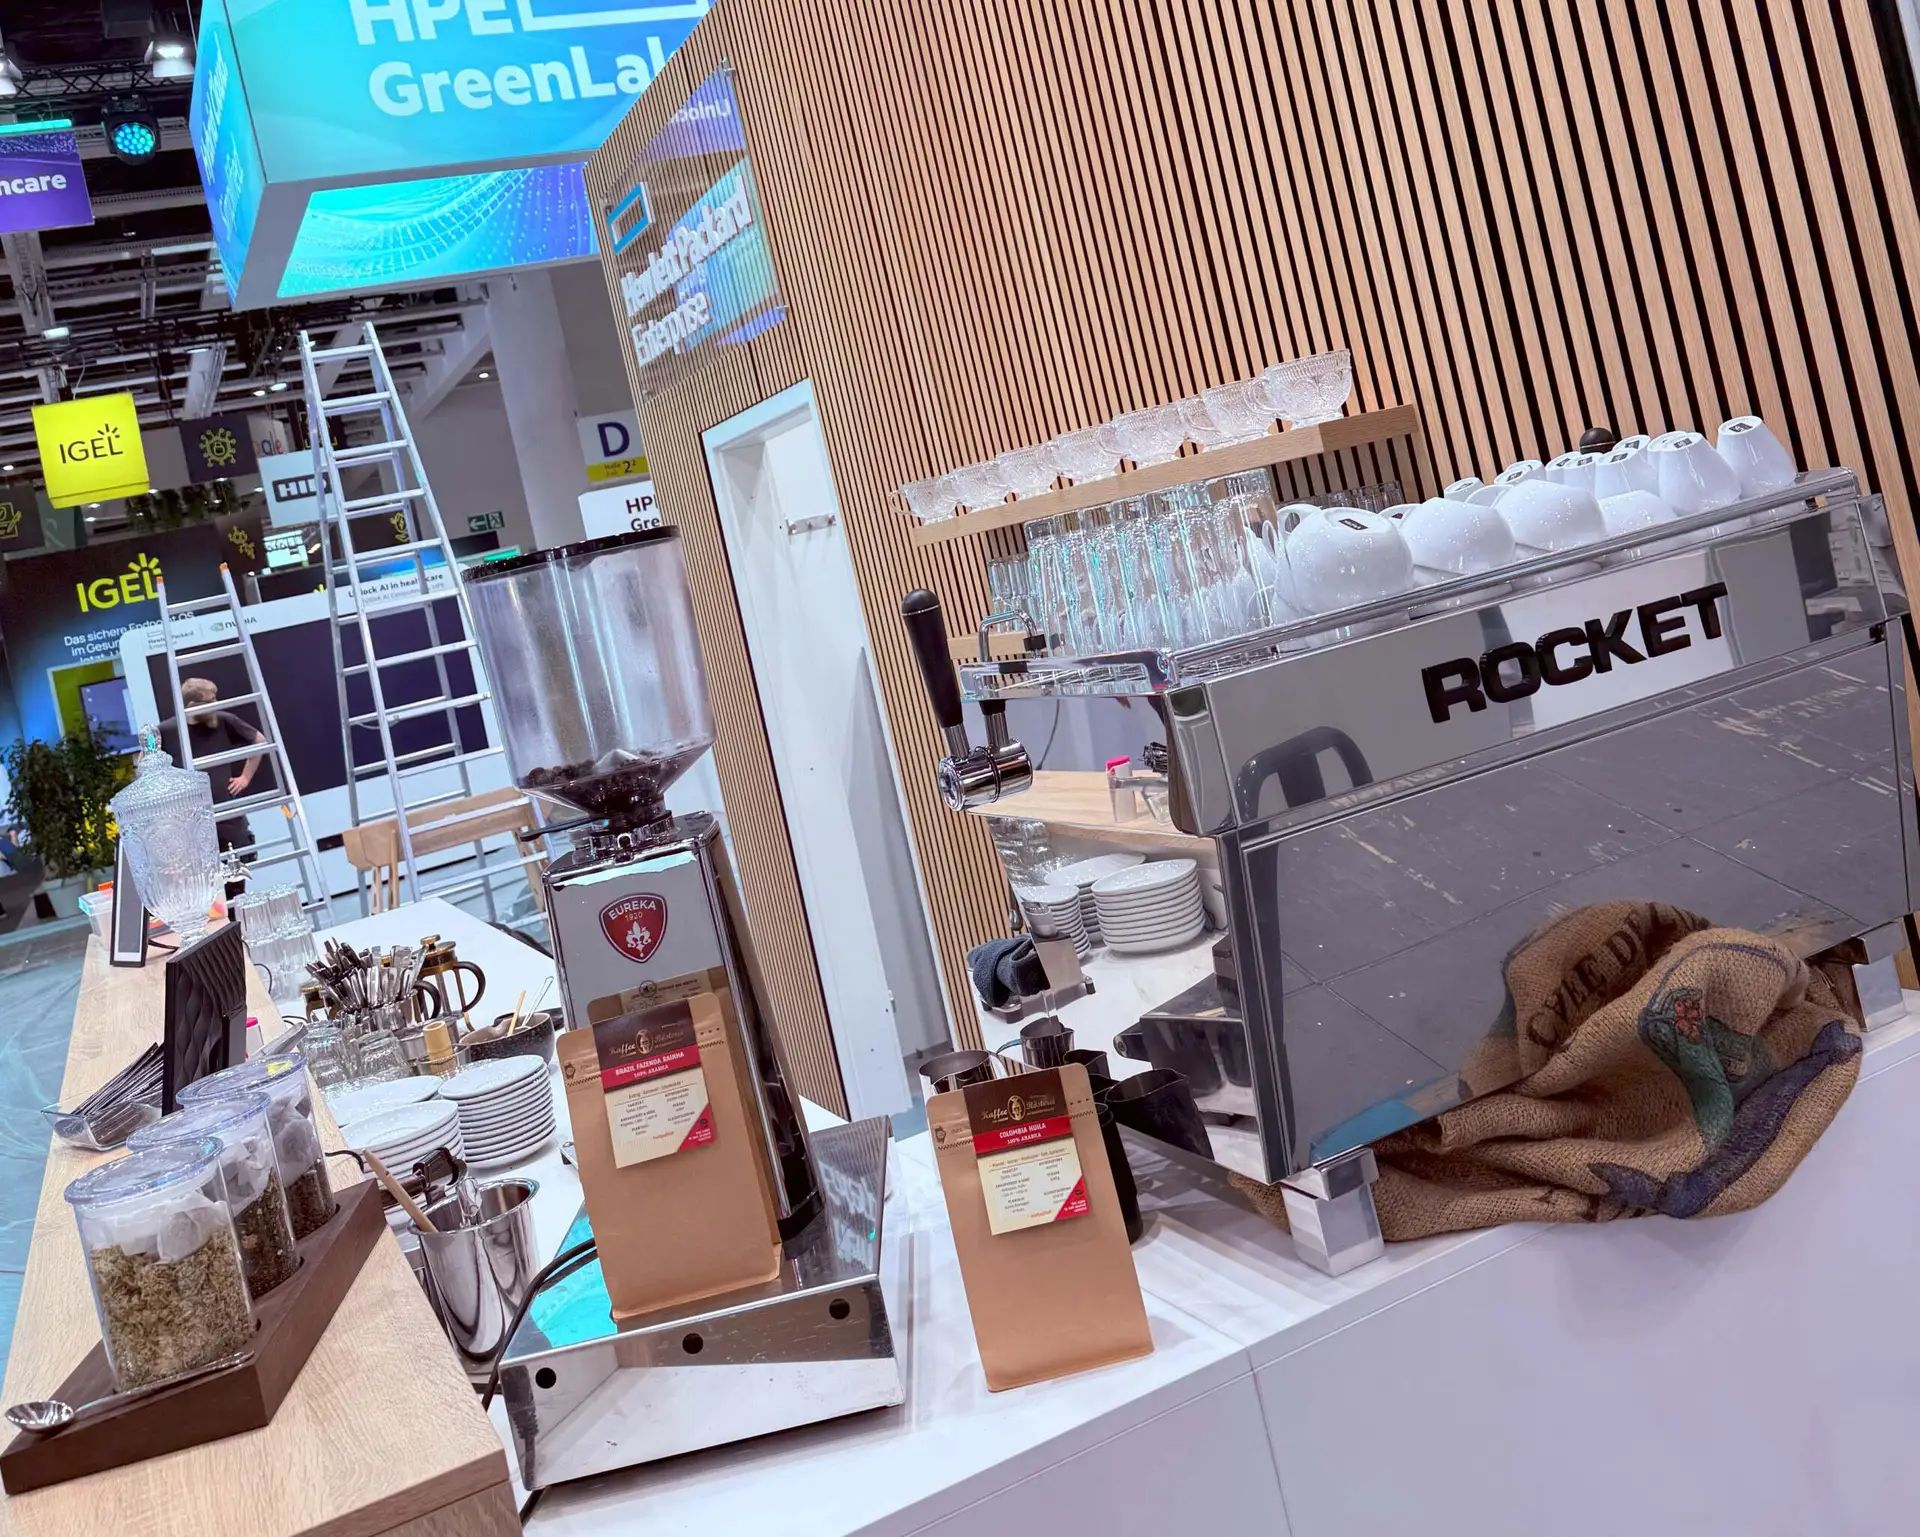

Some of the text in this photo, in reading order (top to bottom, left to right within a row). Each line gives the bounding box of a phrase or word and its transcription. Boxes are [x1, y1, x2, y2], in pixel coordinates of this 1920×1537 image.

[631, 291, 712, 367] Enterprise
[59, 434, 124, 464] IGEL
[597, 422, 630, 457] D
[76, 570, 160, 613] IGEL
[348, 587, 377, 598] Ulock
[64, 635, 86, 646] Das
[87, 625, 128, 642] sichere
[71, 646, 86, 657] im
[1421, 582, 1728, 723] ROCKET
[608, 900, 656, 920] EUREKA
[625, 912, 643, 921] 1920
[615, 1065, 636, 1076] BRAZIL
[636, 1058, 662, 1071] FAZENDA
[981, 1107, 1008, 1121] Kaffee
[999, 1128, 1029, 1140] COLOMBIA
